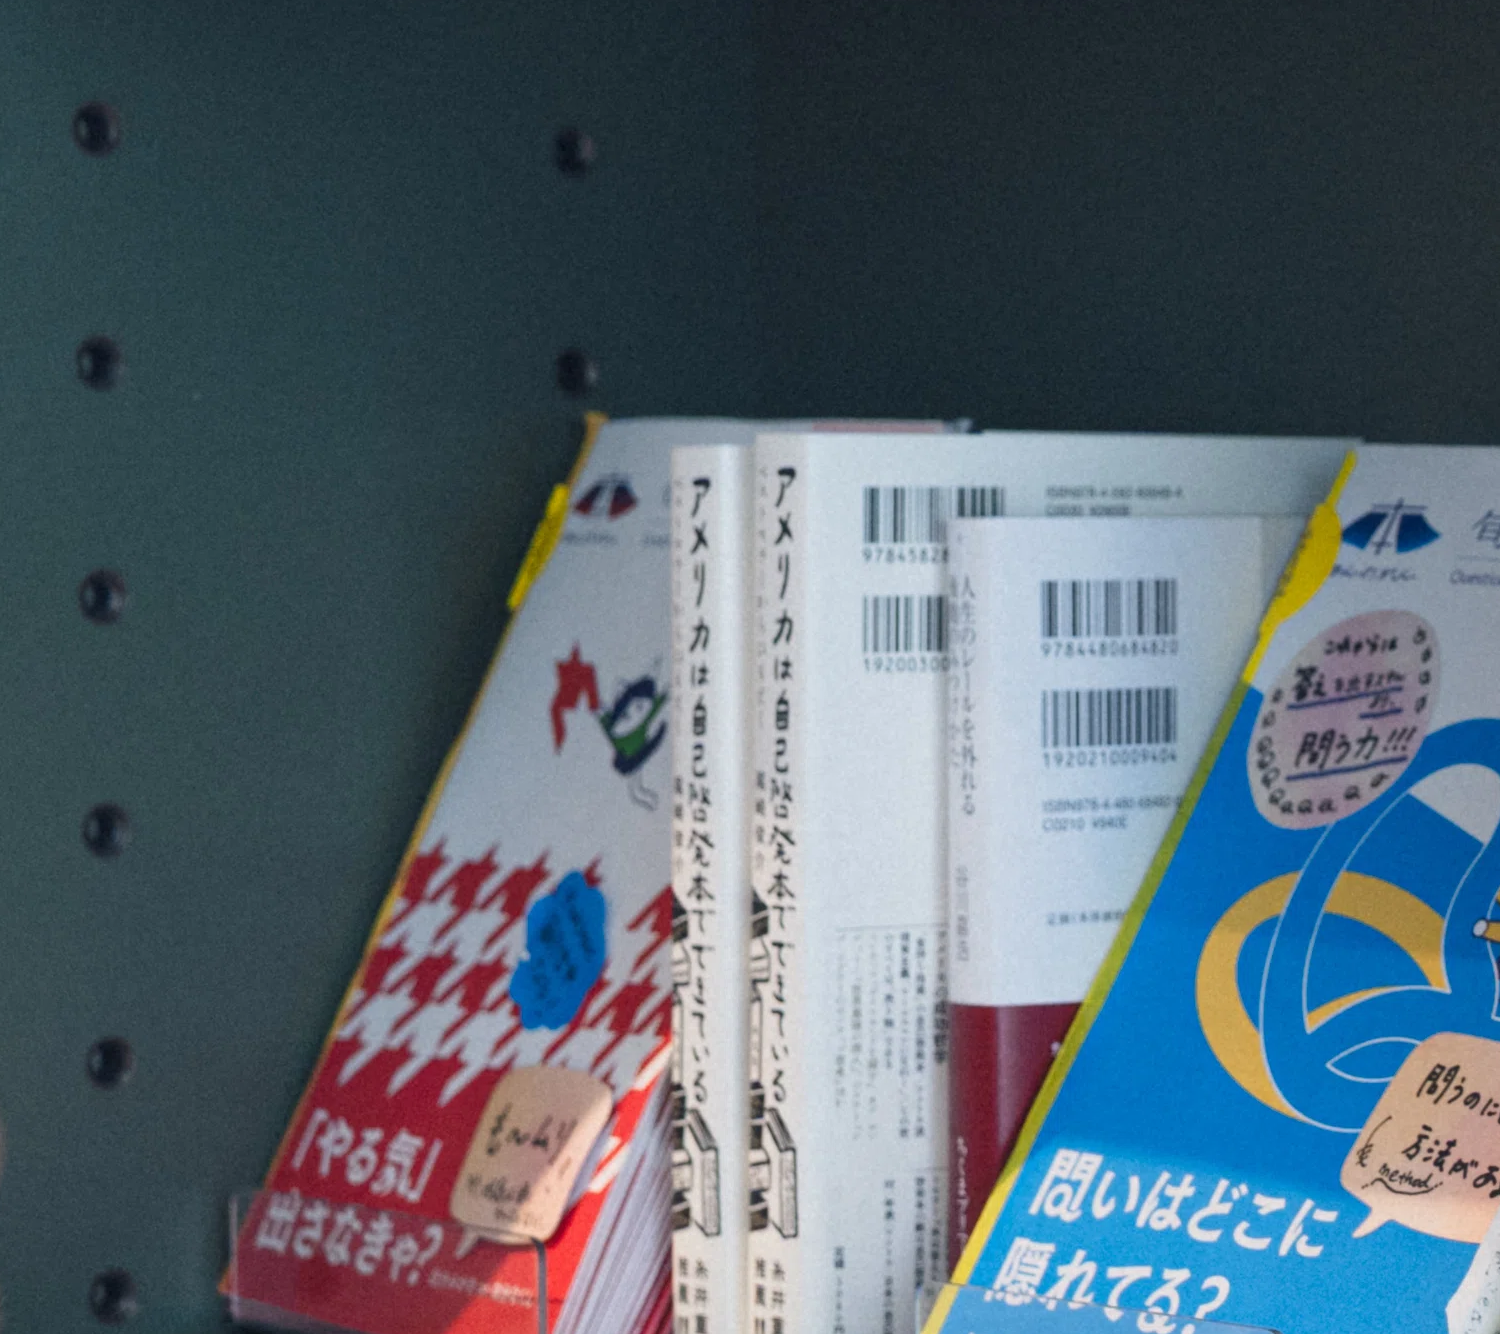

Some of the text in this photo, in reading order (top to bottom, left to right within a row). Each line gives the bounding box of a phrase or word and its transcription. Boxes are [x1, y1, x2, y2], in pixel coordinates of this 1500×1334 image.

[1040, 638, 1179, 658] 9784480684820
[687, 477, 717, 1105] アメリカは自己啓発本でできている
[768, 467, 798, 1104] アメリカは自己啓発本でできている
[292, 1108, 442, 1203] 「やる気」
[1028, 1148, 1338, 1259] 問いはどこに
[1379, 1164, 1432, 1189] method
[256, 1189, 442, 1286] 出さなきゃ？
